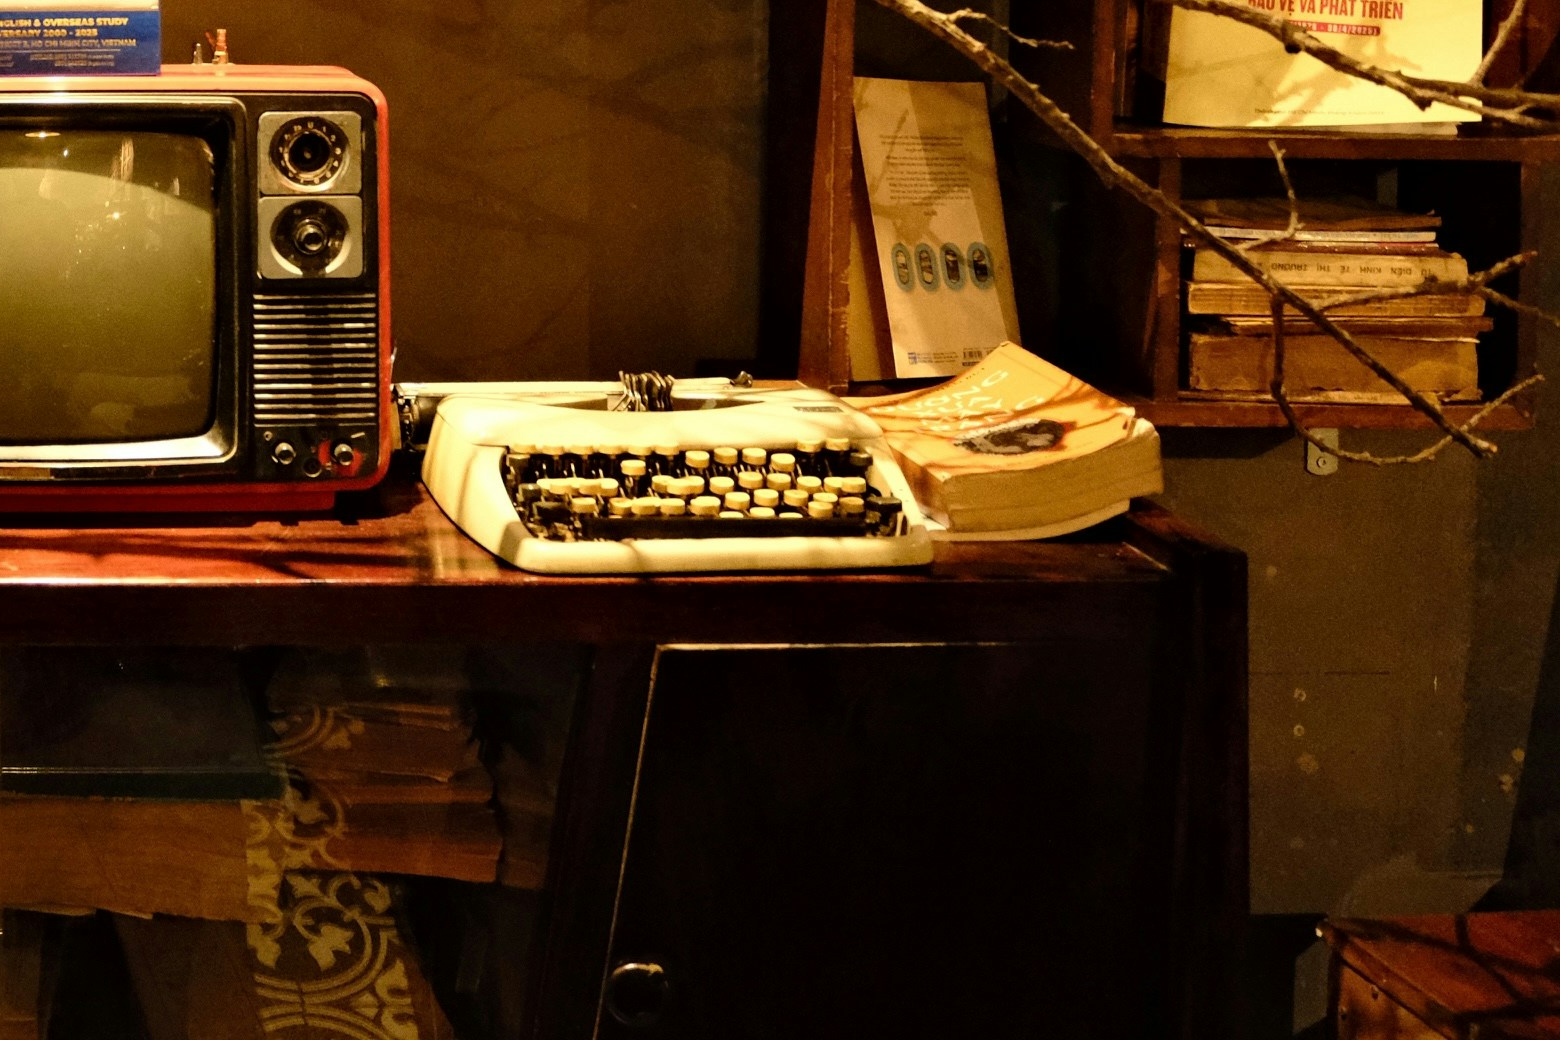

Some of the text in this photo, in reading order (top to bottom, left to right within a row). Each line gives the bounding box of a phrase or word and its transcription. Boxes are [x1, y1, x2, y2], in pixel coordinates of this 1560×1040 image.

[33, 19, 41, 27] &
[42, 18, 95, 27] OVERSEAS
[96, 17, 129, 26] STUDY
[75, 28, 98, 37] 2025
[44, 39, 58, 47] CHI
[101, 38, 137, 47] VIETNAM
[1359, 266, 1382, 275] KINH
